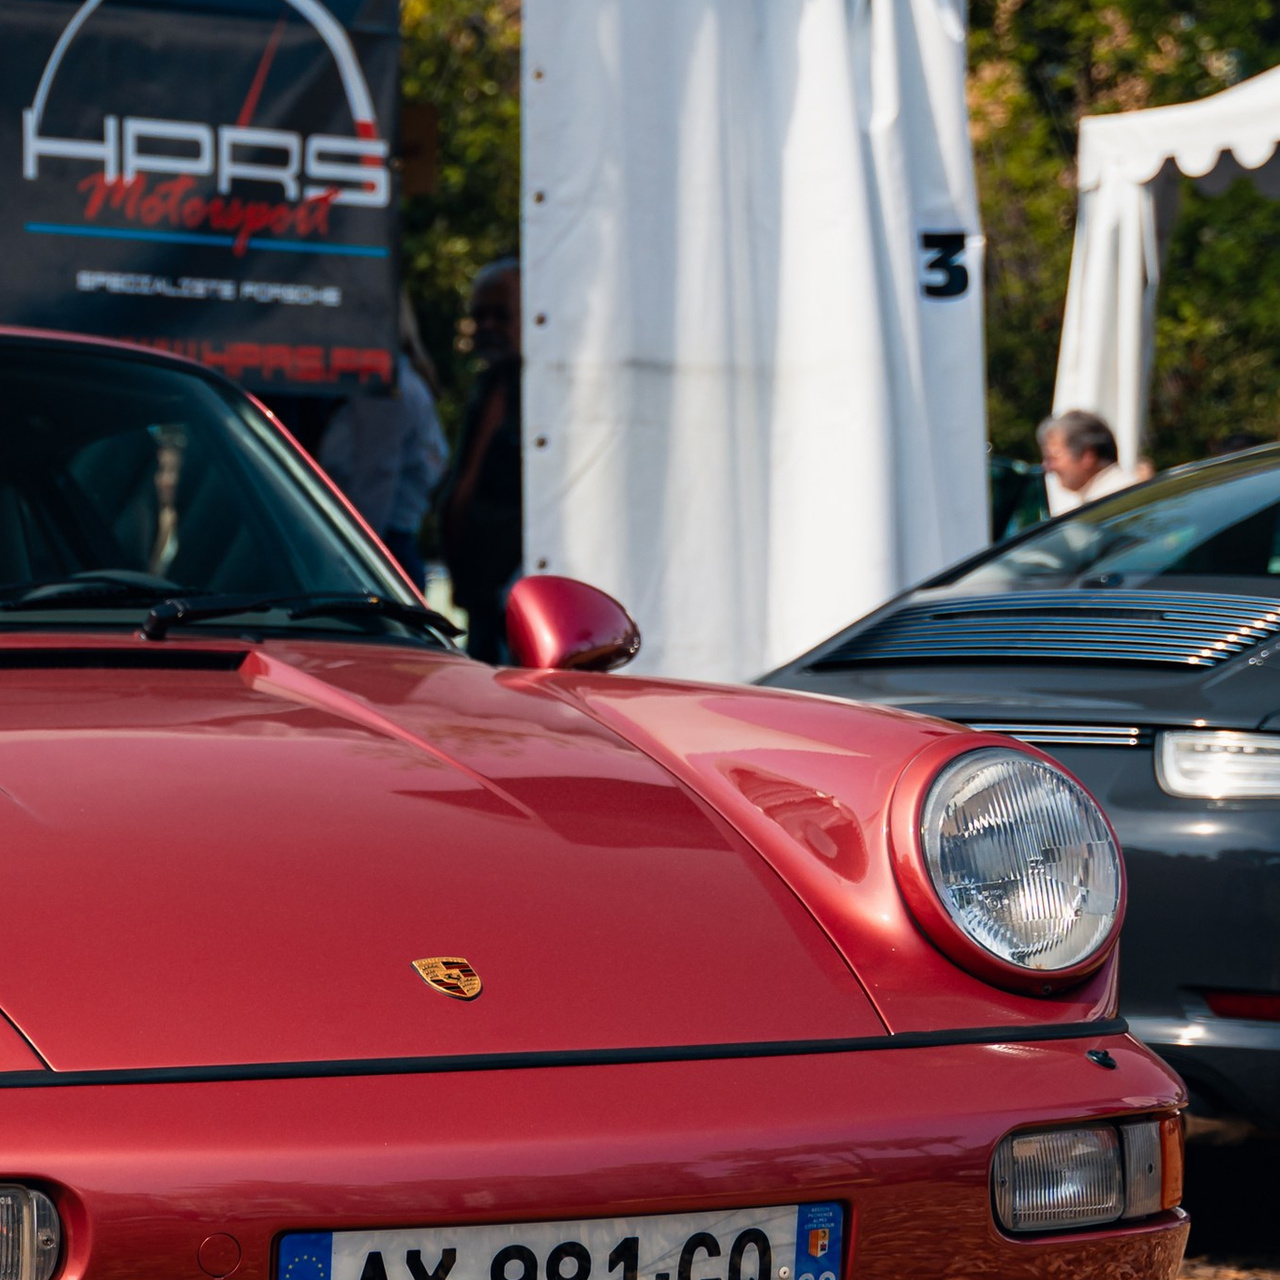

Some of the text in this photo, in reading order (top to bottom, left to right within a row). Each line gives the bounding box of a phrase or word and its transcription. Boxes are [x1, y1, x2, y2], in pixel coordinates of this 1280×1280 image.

[22, 108, 391, 208] HPRS
[77, 170, 341, 258] Motorsport
[239, 282, 342, 307] PORSCHE
[922, 232, 969, 297] 3
